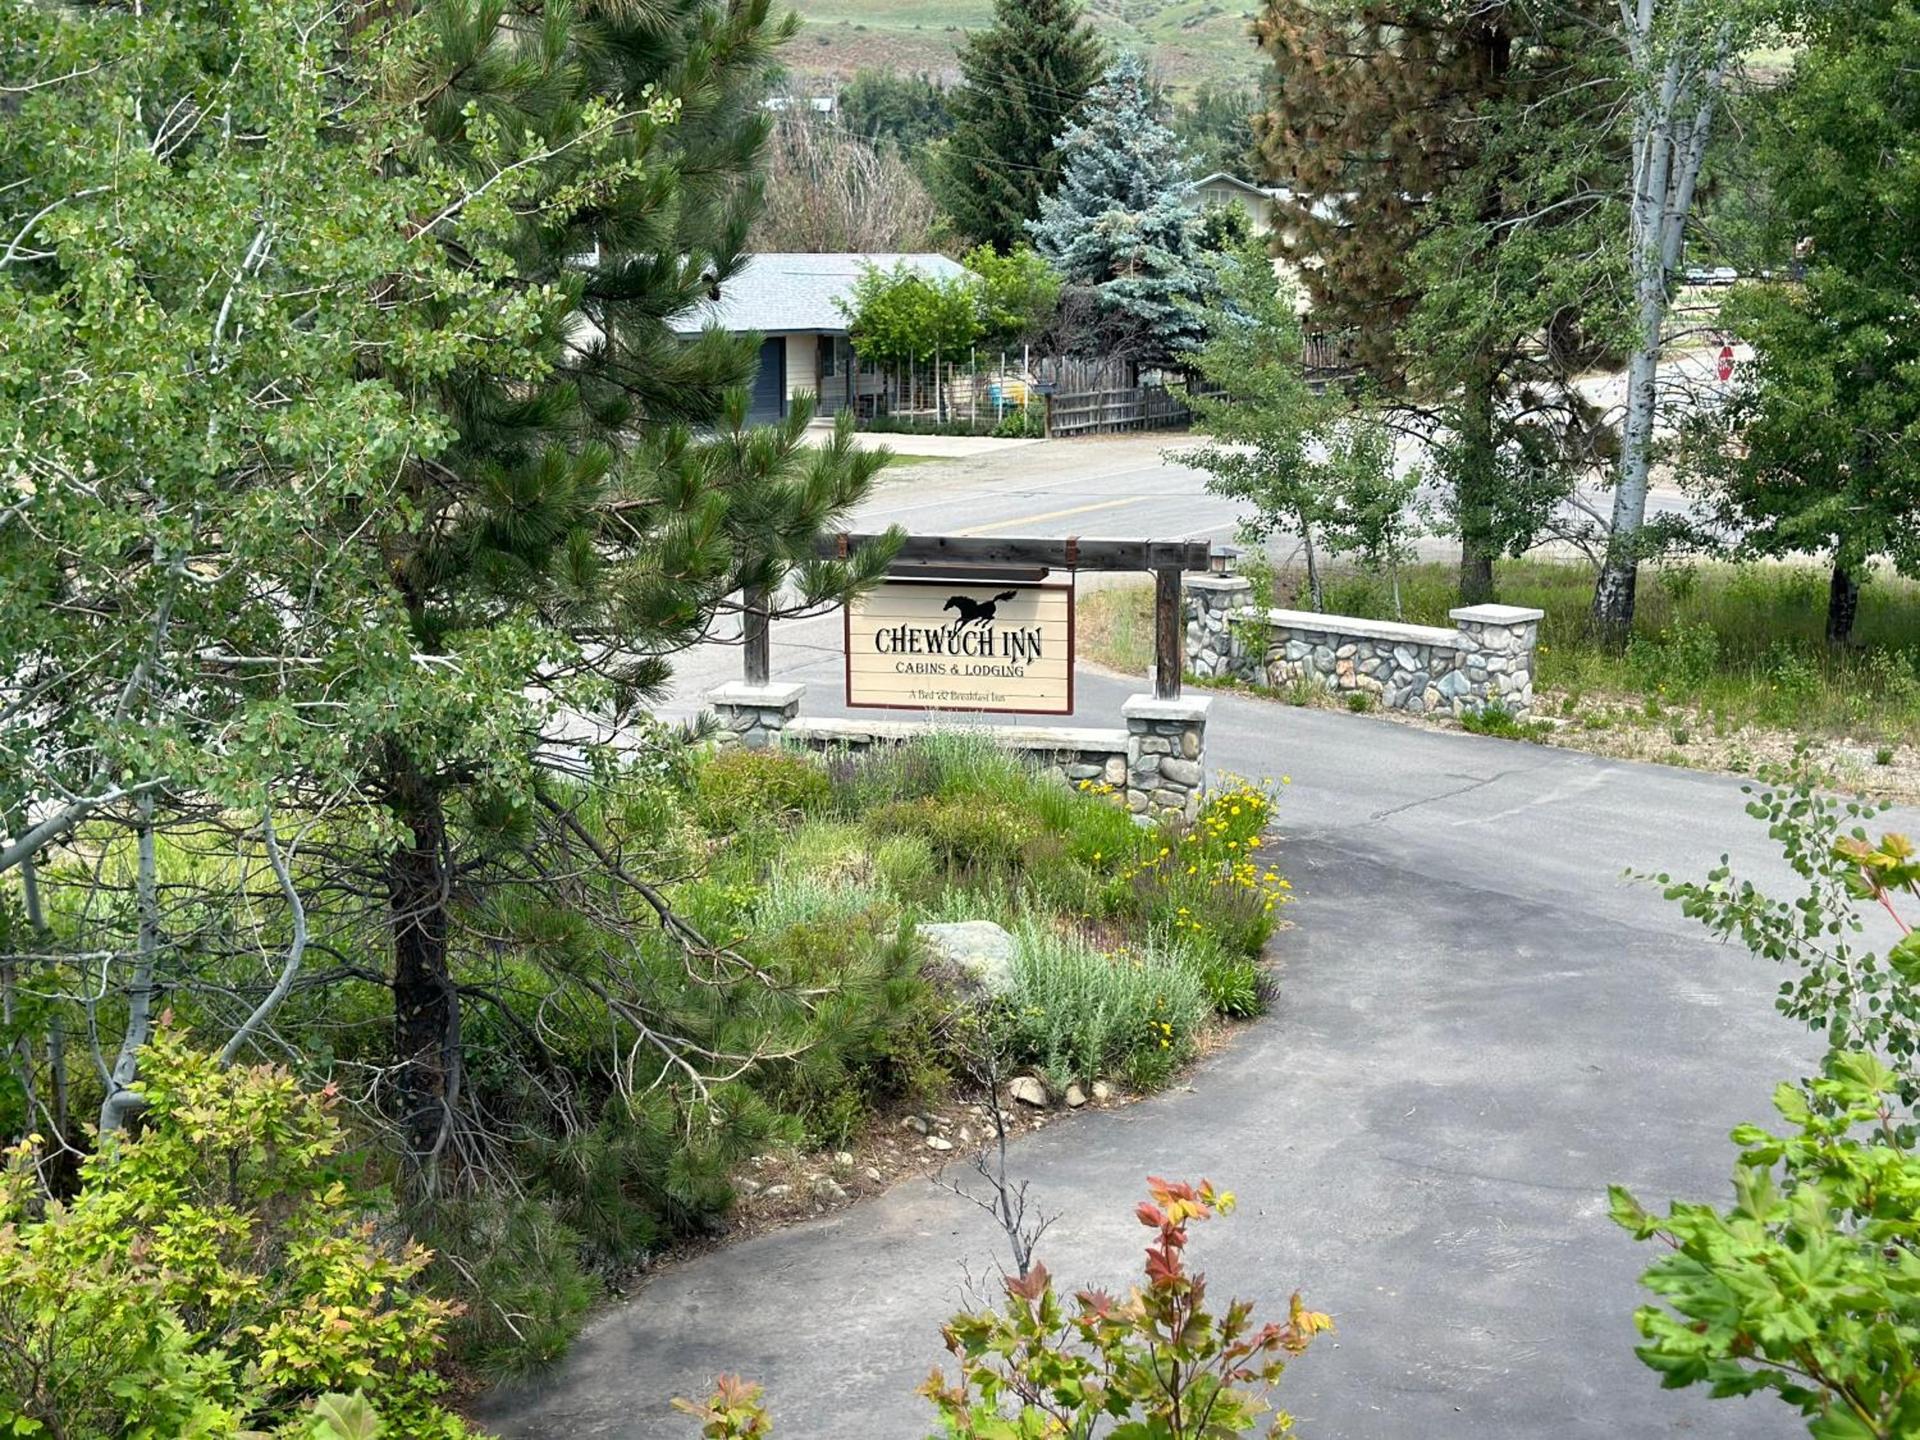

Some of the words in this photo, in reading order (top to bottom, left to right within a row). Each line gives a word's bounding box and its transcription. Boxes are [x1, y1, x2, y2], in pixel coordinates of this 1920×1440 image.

[875, 622, 995, 656] CHEWUCH
[1003, 626, 1042, 666] INN
[896, 661, 946, 675] CABINS
[950, 664, 959, 675] &
[965, 664, 1024, 678] LODGING
[909, 690, 916, 699] A
[918, 689, 934, 700] Bed
[937, 690, 949, 701] &
[951, 690, 989, 702] Breakfast
[991, 691, 1006, 702] Inn
